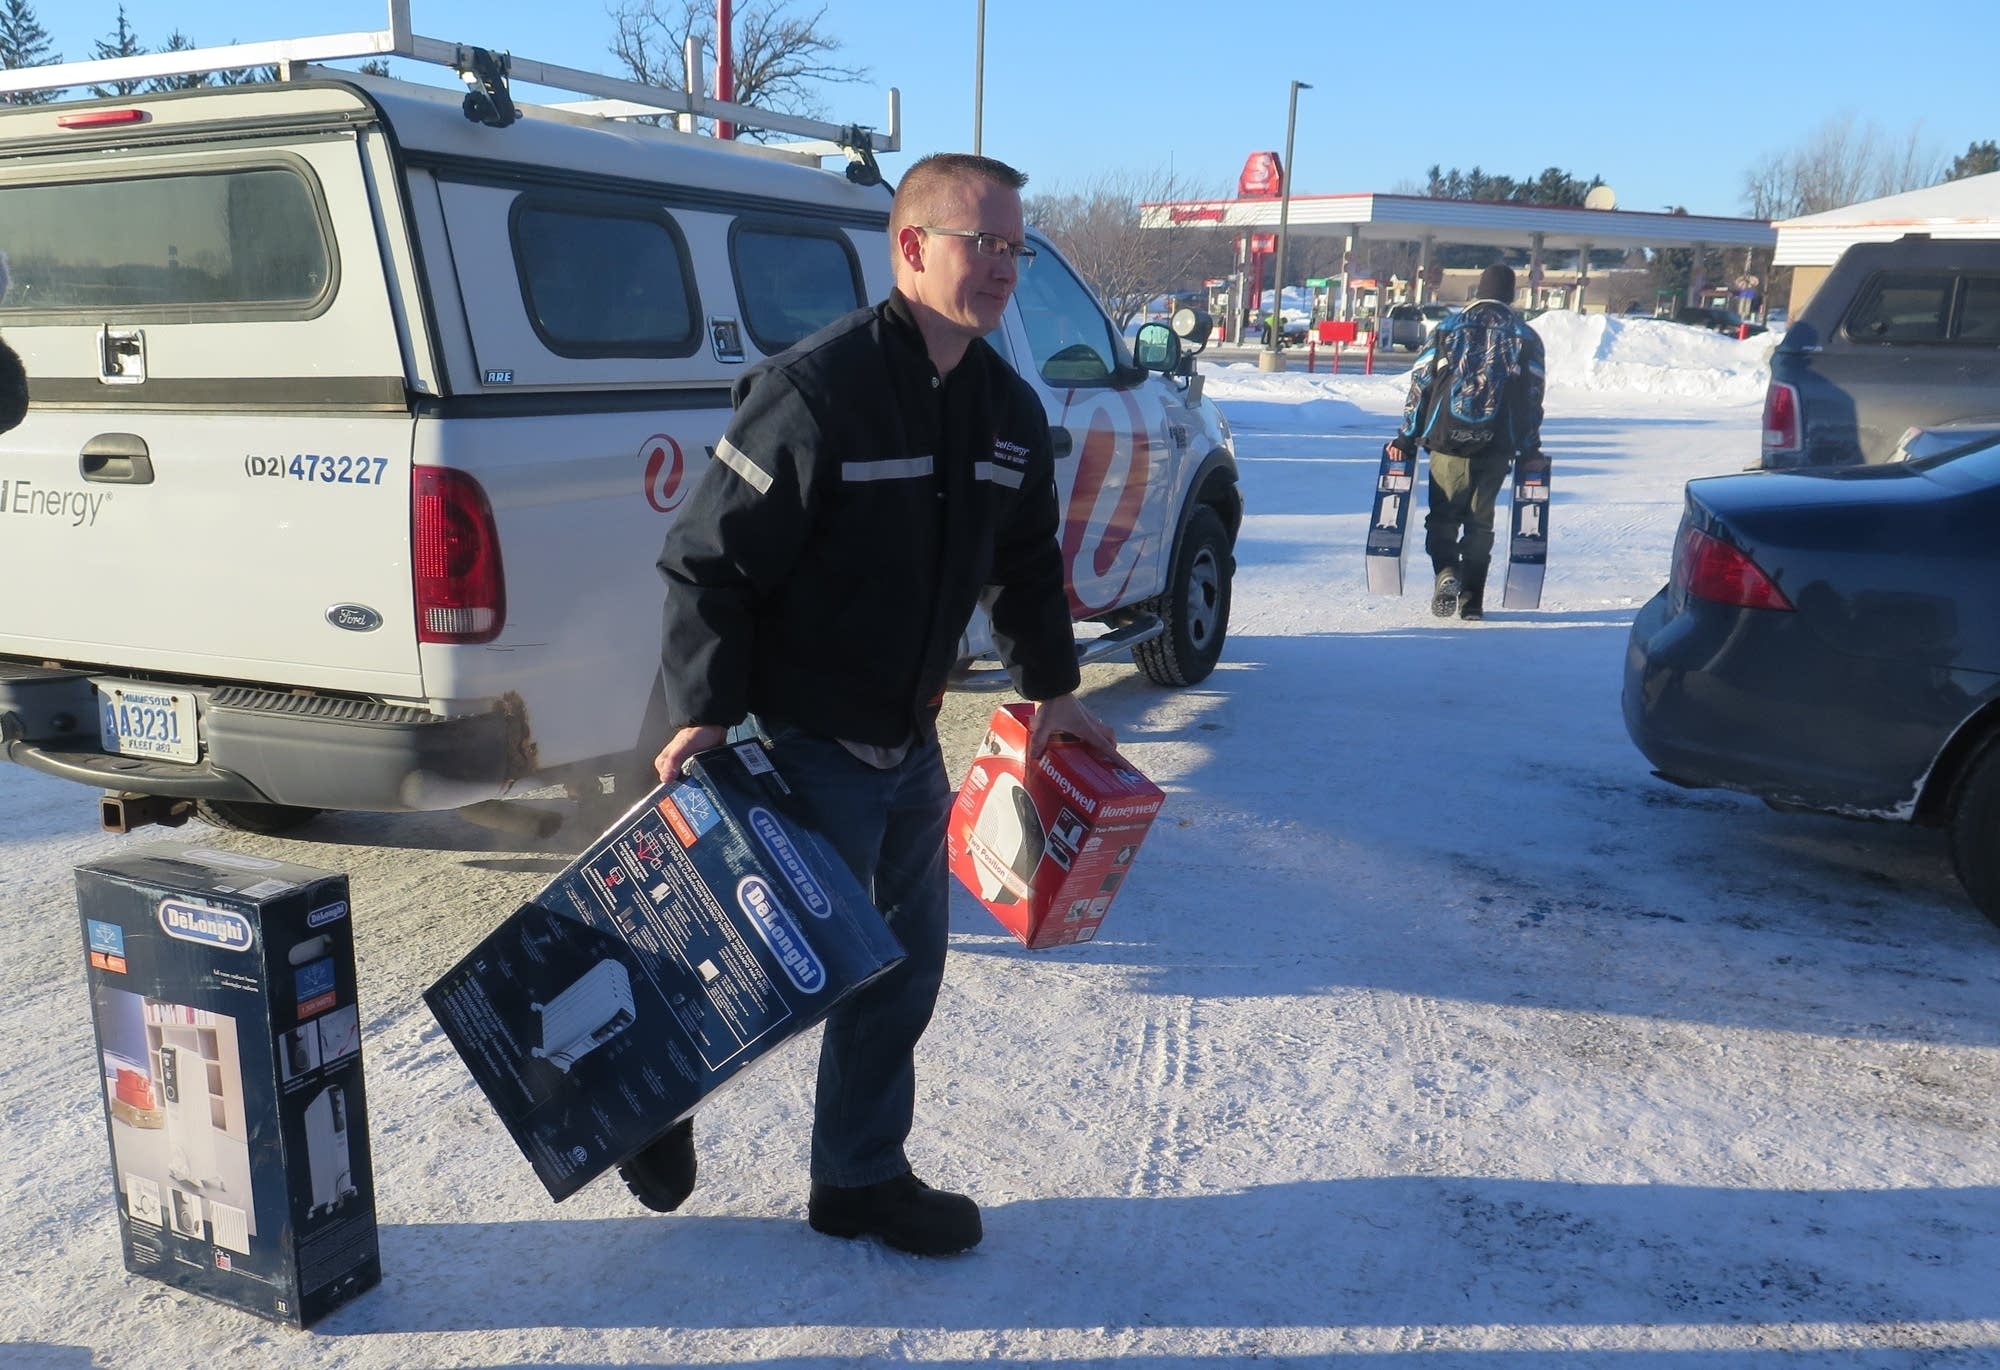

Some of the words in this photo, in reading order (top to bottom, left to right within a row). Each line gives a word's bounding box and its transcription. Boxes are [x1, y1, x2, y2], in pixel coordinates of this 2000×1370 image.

[245, 454, 286, 479] (D2)
[288, 454, 388, 485] 473227
[338, 608, 367, 625] Ford
[122, 692, 172, 707] MINNESOTA
[129, 740, 153, 751] FLEET
[1039, 755, 1097, 814] Honeywell
[1099, 801, 1160, 818] Honeywell
[980, 848, 1006, 877] Position
